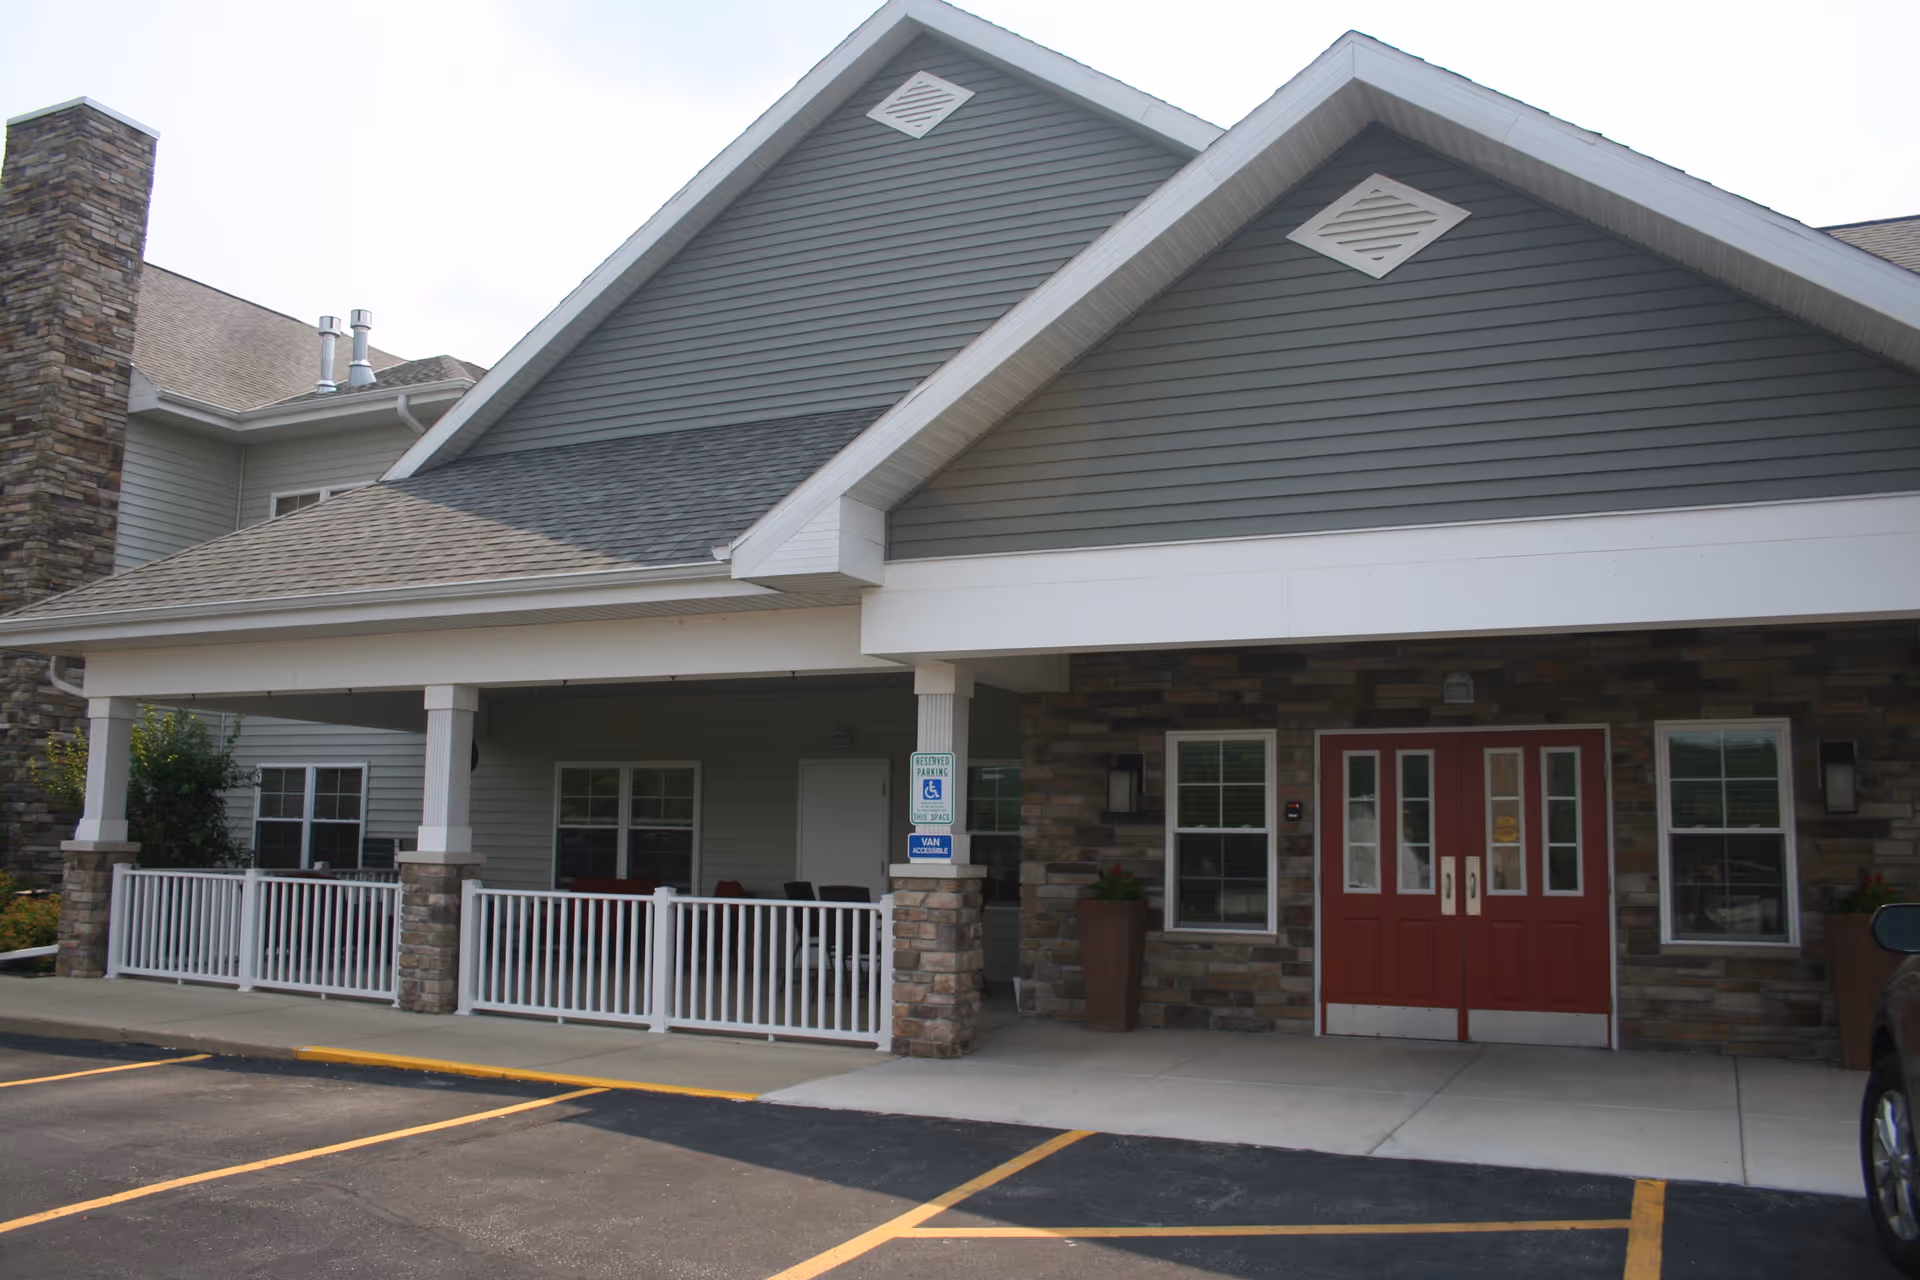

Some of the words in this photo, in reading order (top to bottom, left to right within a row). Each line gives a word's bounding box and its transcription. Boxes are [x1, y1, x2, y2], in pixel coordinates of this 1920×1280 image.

[916, 756, 950, 766] RESERVED
[917, 767, 948, 777] PARKING
[913, 813, 928, 821] THIS
[930, 813, 950, 821] SPACE
[921, 837, 941, 847] VAN
[912, 847, 949, 855] ACCESSIBLE
